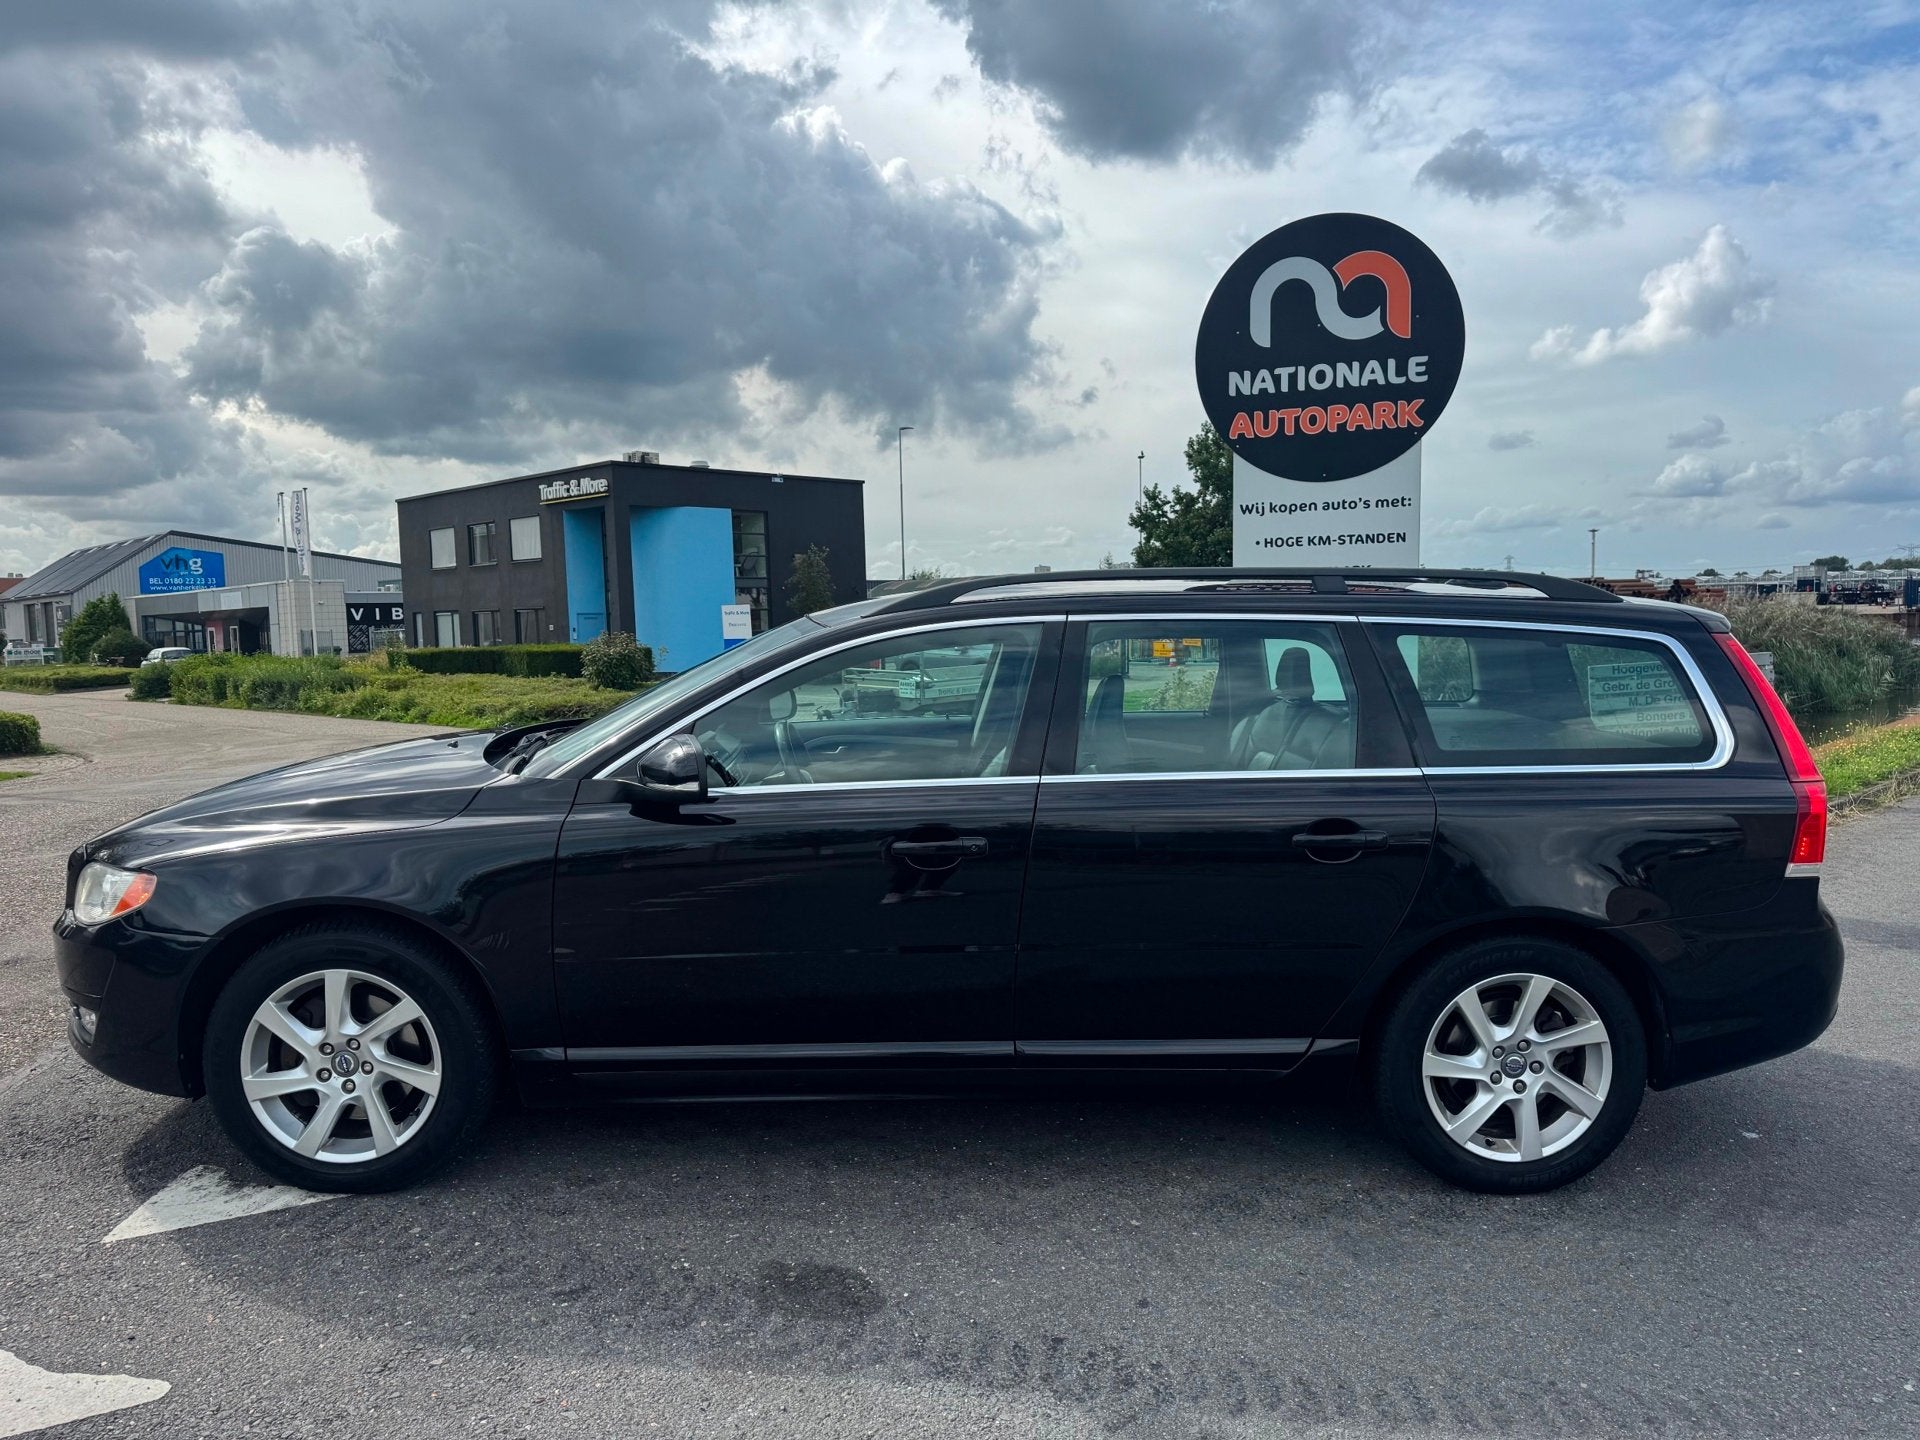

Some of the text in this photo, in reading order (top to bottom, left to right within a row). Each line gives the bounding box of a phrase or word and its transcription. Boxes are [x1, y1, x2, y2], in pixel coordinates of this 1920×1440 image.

[1228, 355, 1429, 397] NATIONALE
[1228, 398, 1425, 439] AUTOPARK
[539, 477, 609, 501] Traffic & More
[1239, 496, 1412, 517] Wij kopen auto's met:
[1264, 532, 1407, 548] HOGE KM-STANDEN
[161, 554, 203, 574] vhg
[1611, 664, 1665, 675] Hoogeve
[1602, 682, 1633, 692] Gebr.
[1636, 680, 1651, 690] de
